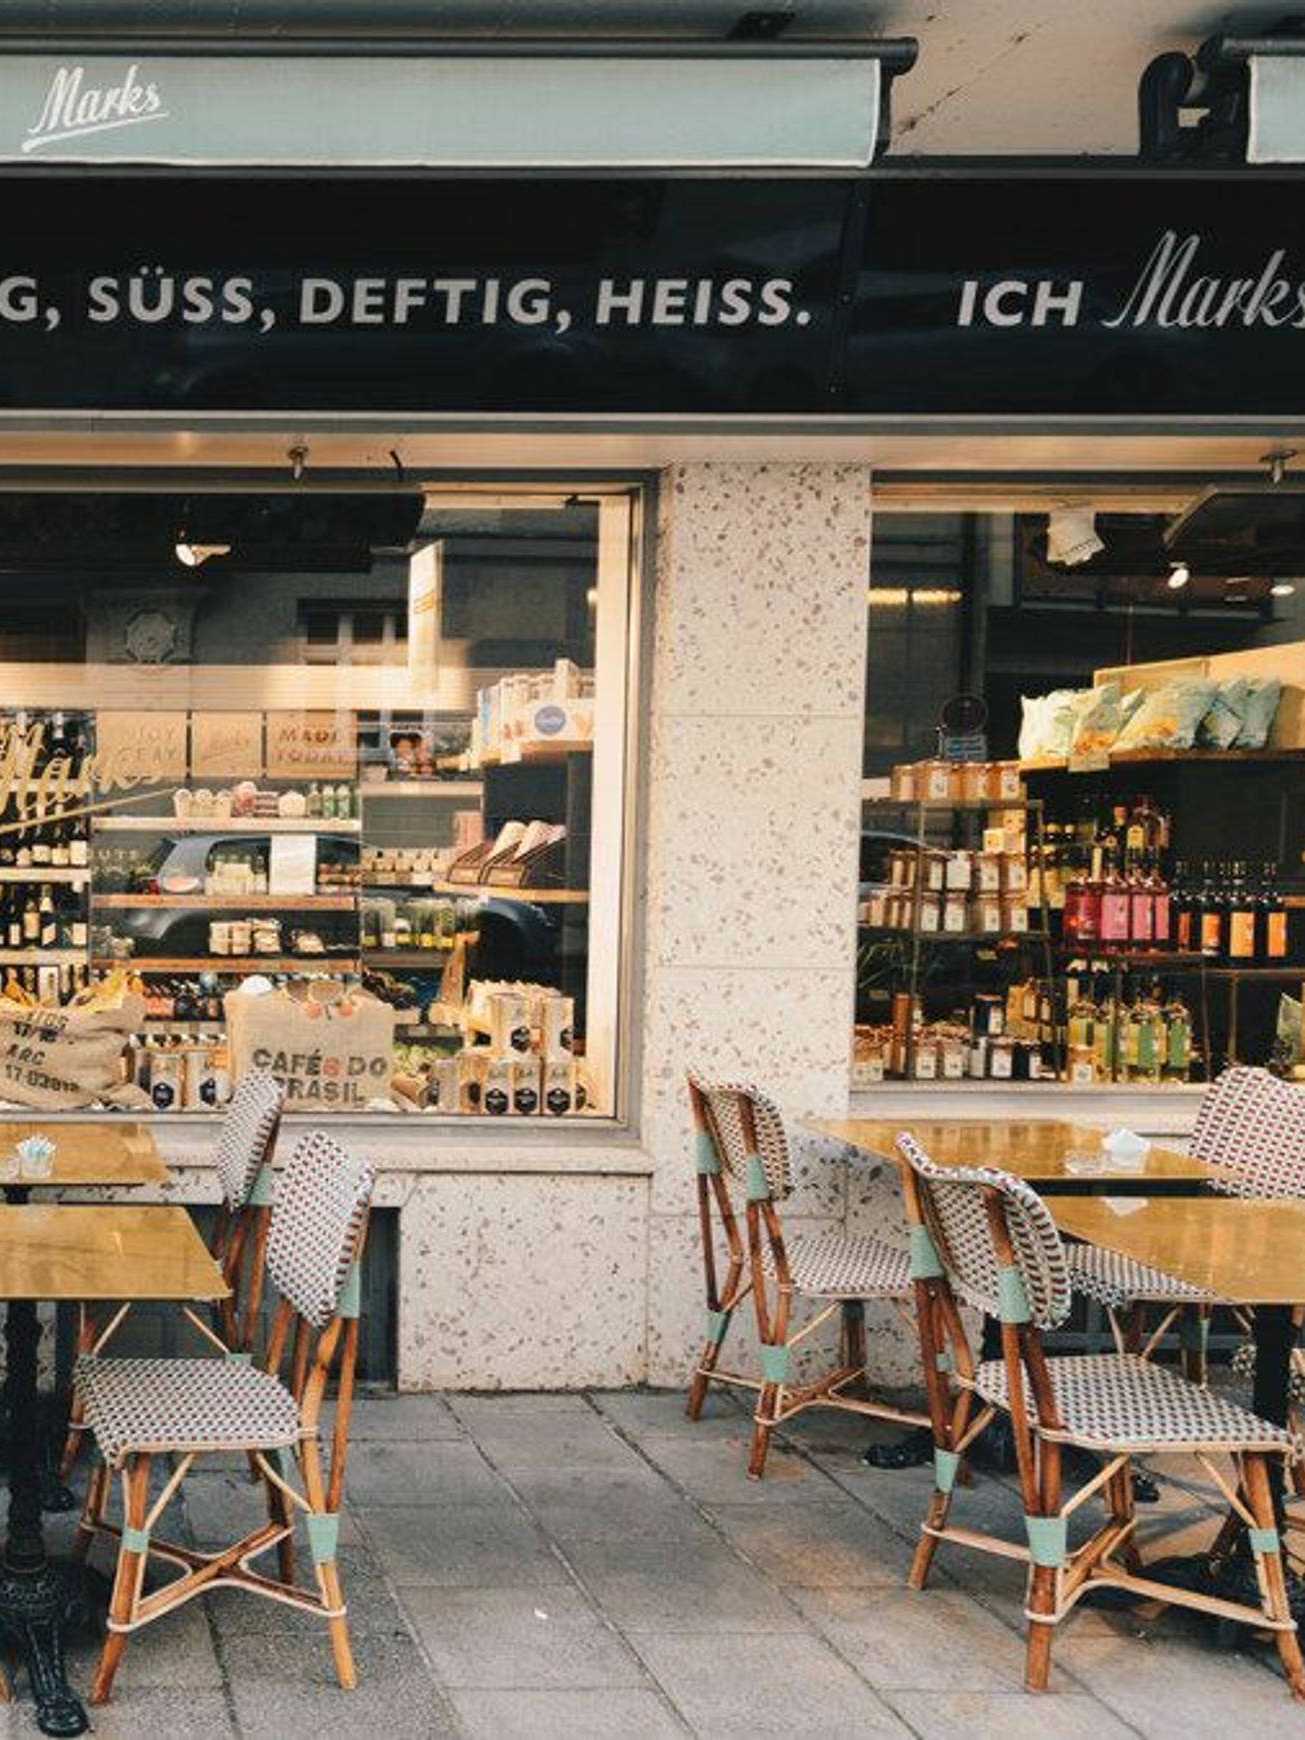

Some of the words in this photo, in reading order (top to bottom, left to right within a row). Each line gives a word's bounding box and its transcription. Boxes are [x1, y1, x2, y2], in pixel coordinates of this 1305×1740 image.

[23, 64, 164, 142] Marks
[88, 265, 275, 333] SÜSS,
[301, 279, 571, 334] DEFTIG,
[596, 279, 810, 325] HEISS.
[958, 281, 1083, 326] ICH
[347, 1056, 388, 1077] DO
